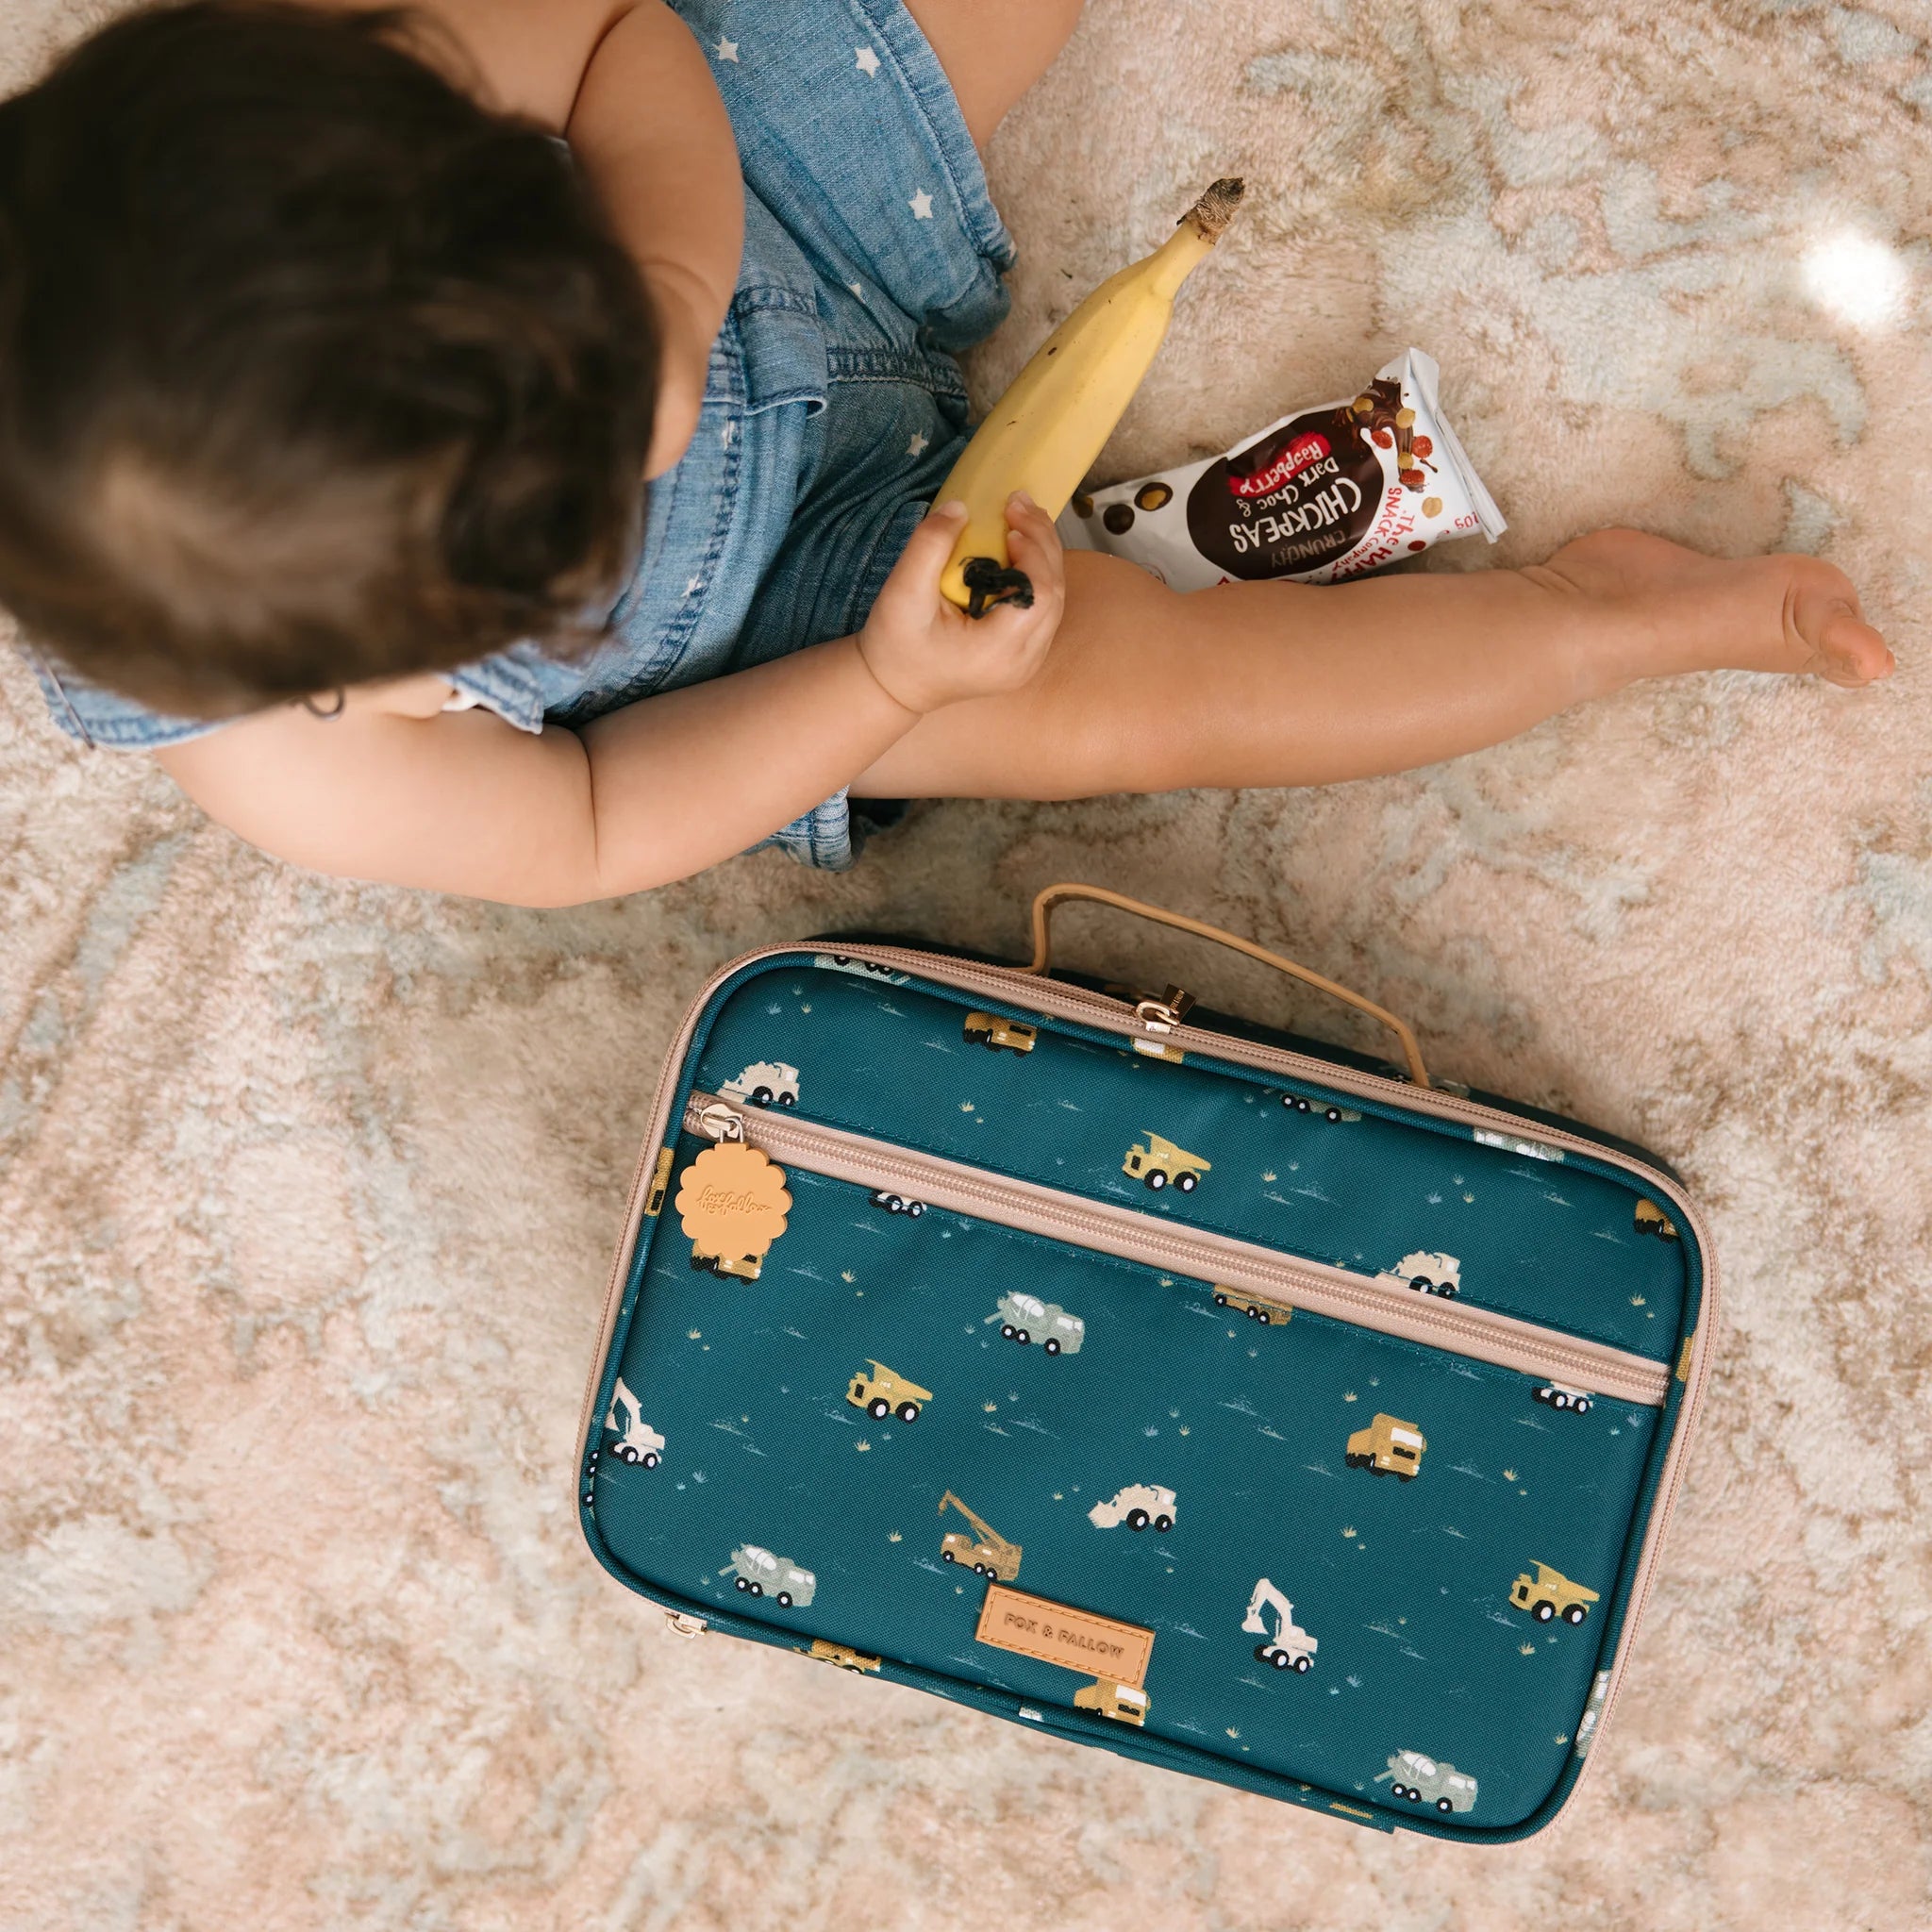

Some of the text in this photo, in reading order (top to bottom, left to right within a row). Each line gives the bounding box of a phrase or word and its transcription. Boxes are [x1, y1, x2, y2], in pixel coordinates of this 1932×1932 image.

[1235, 457, 1340, 518] Dark Choc &
[1239, 441, 1324, 495] Raspberry
[1228, 476, 1362, 554] CHICKPEAS
[1331, 487, 1402, 572] SNACK Company
[1386, 514, 1415, 546] The
[1272, 529, 1346, 567] CRUNCHY
[1004, 1611, 1125, 1660] FOX & FALLOW
